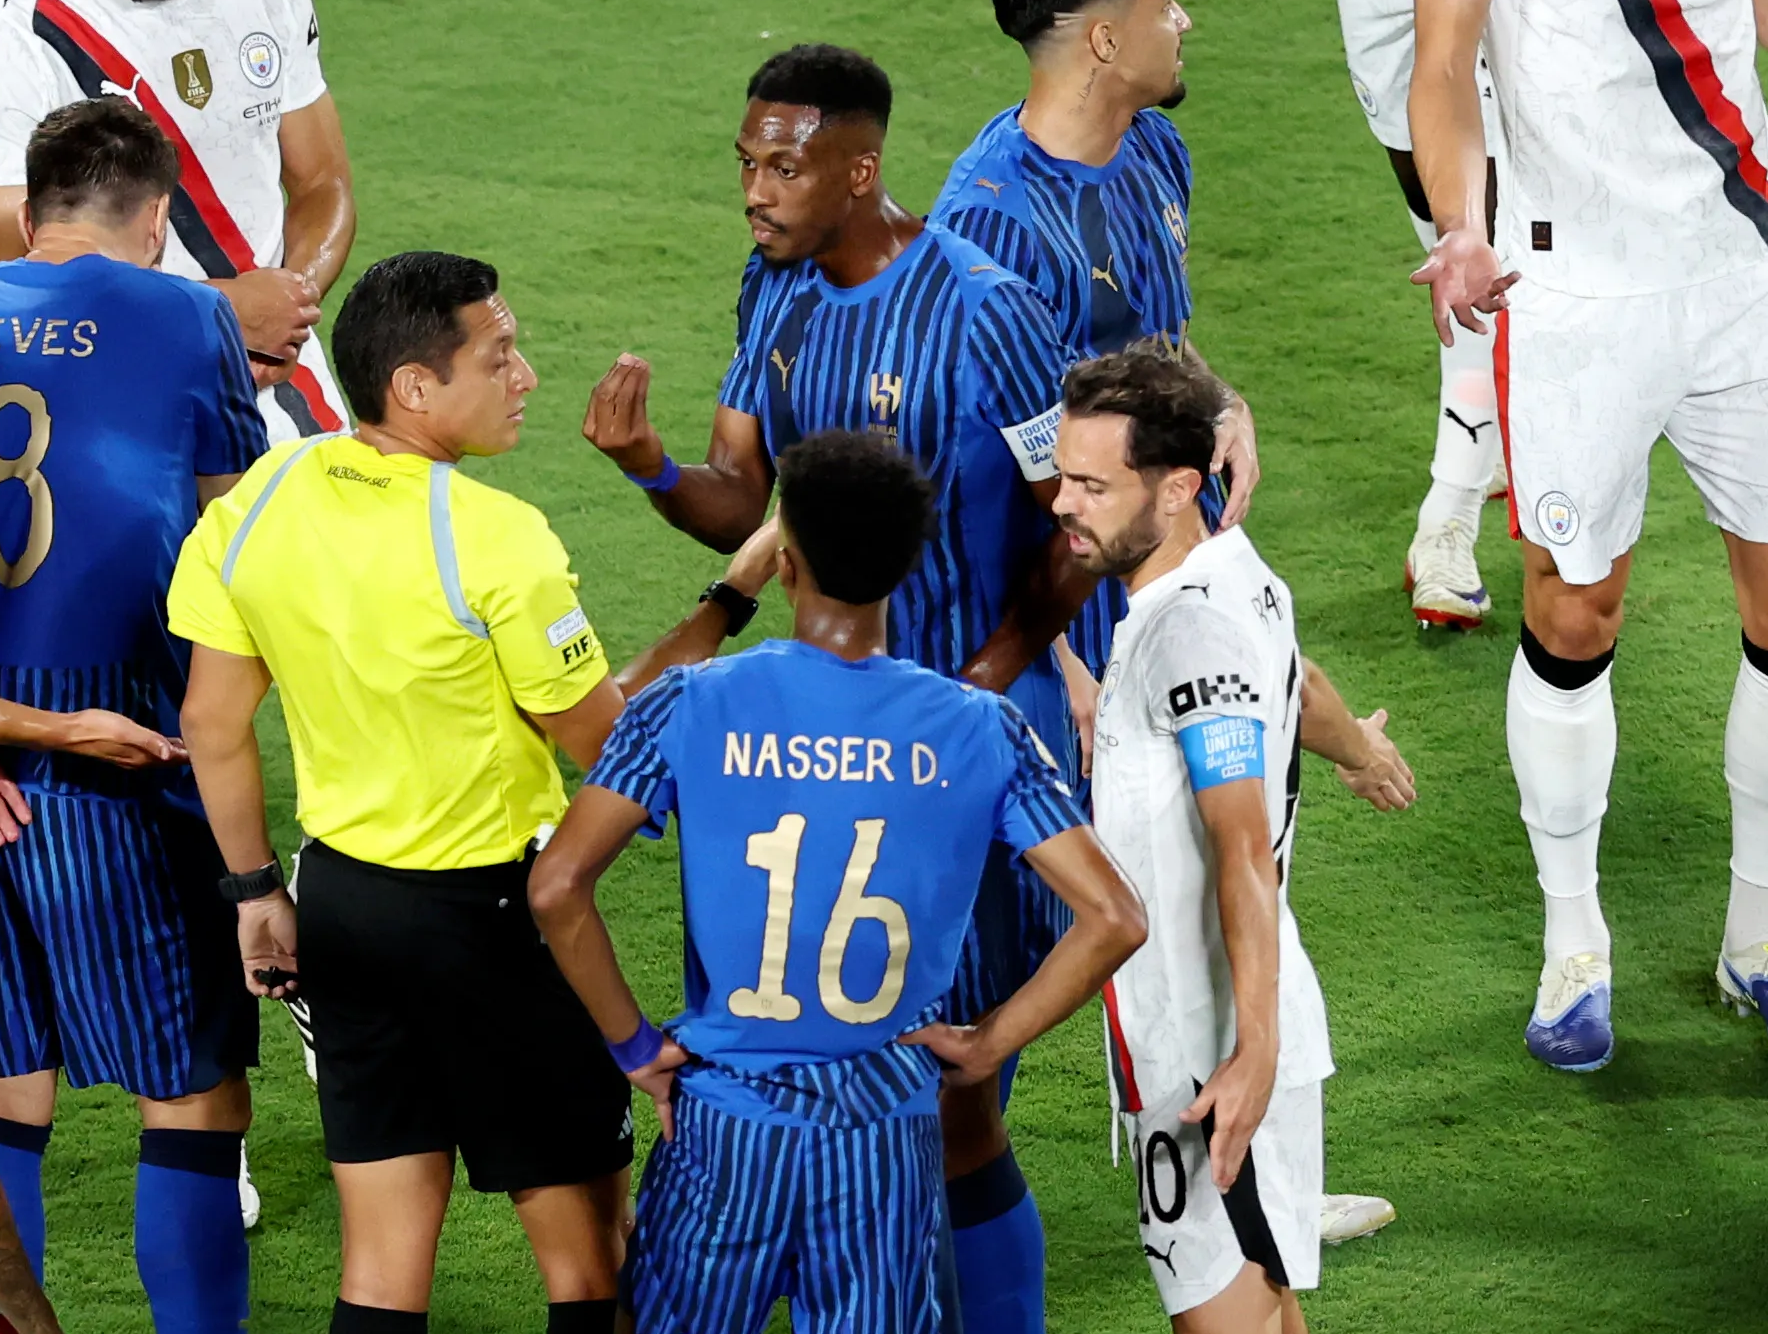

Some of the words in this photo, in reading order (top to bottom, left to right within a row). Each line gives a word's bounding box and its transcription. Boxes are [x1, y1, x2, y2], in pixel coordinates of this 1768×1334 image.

[187, 86, 206, 98] FIFA
[243, 97, 281, 119] ETIH
[1017, 407, 1064, 439] FOOTBA
[1022, 426, 1058, 452] UNIT
[562, 635, 592, 665] FIF
[1202, 717, 1253, 737] FOOTBALL
[1204, 729, 1257, 755] UNITES
[723, 731, 894, 783] NASSER
[911, 741, 949, 788] D.
[726, 813, 911, 1025] 16
